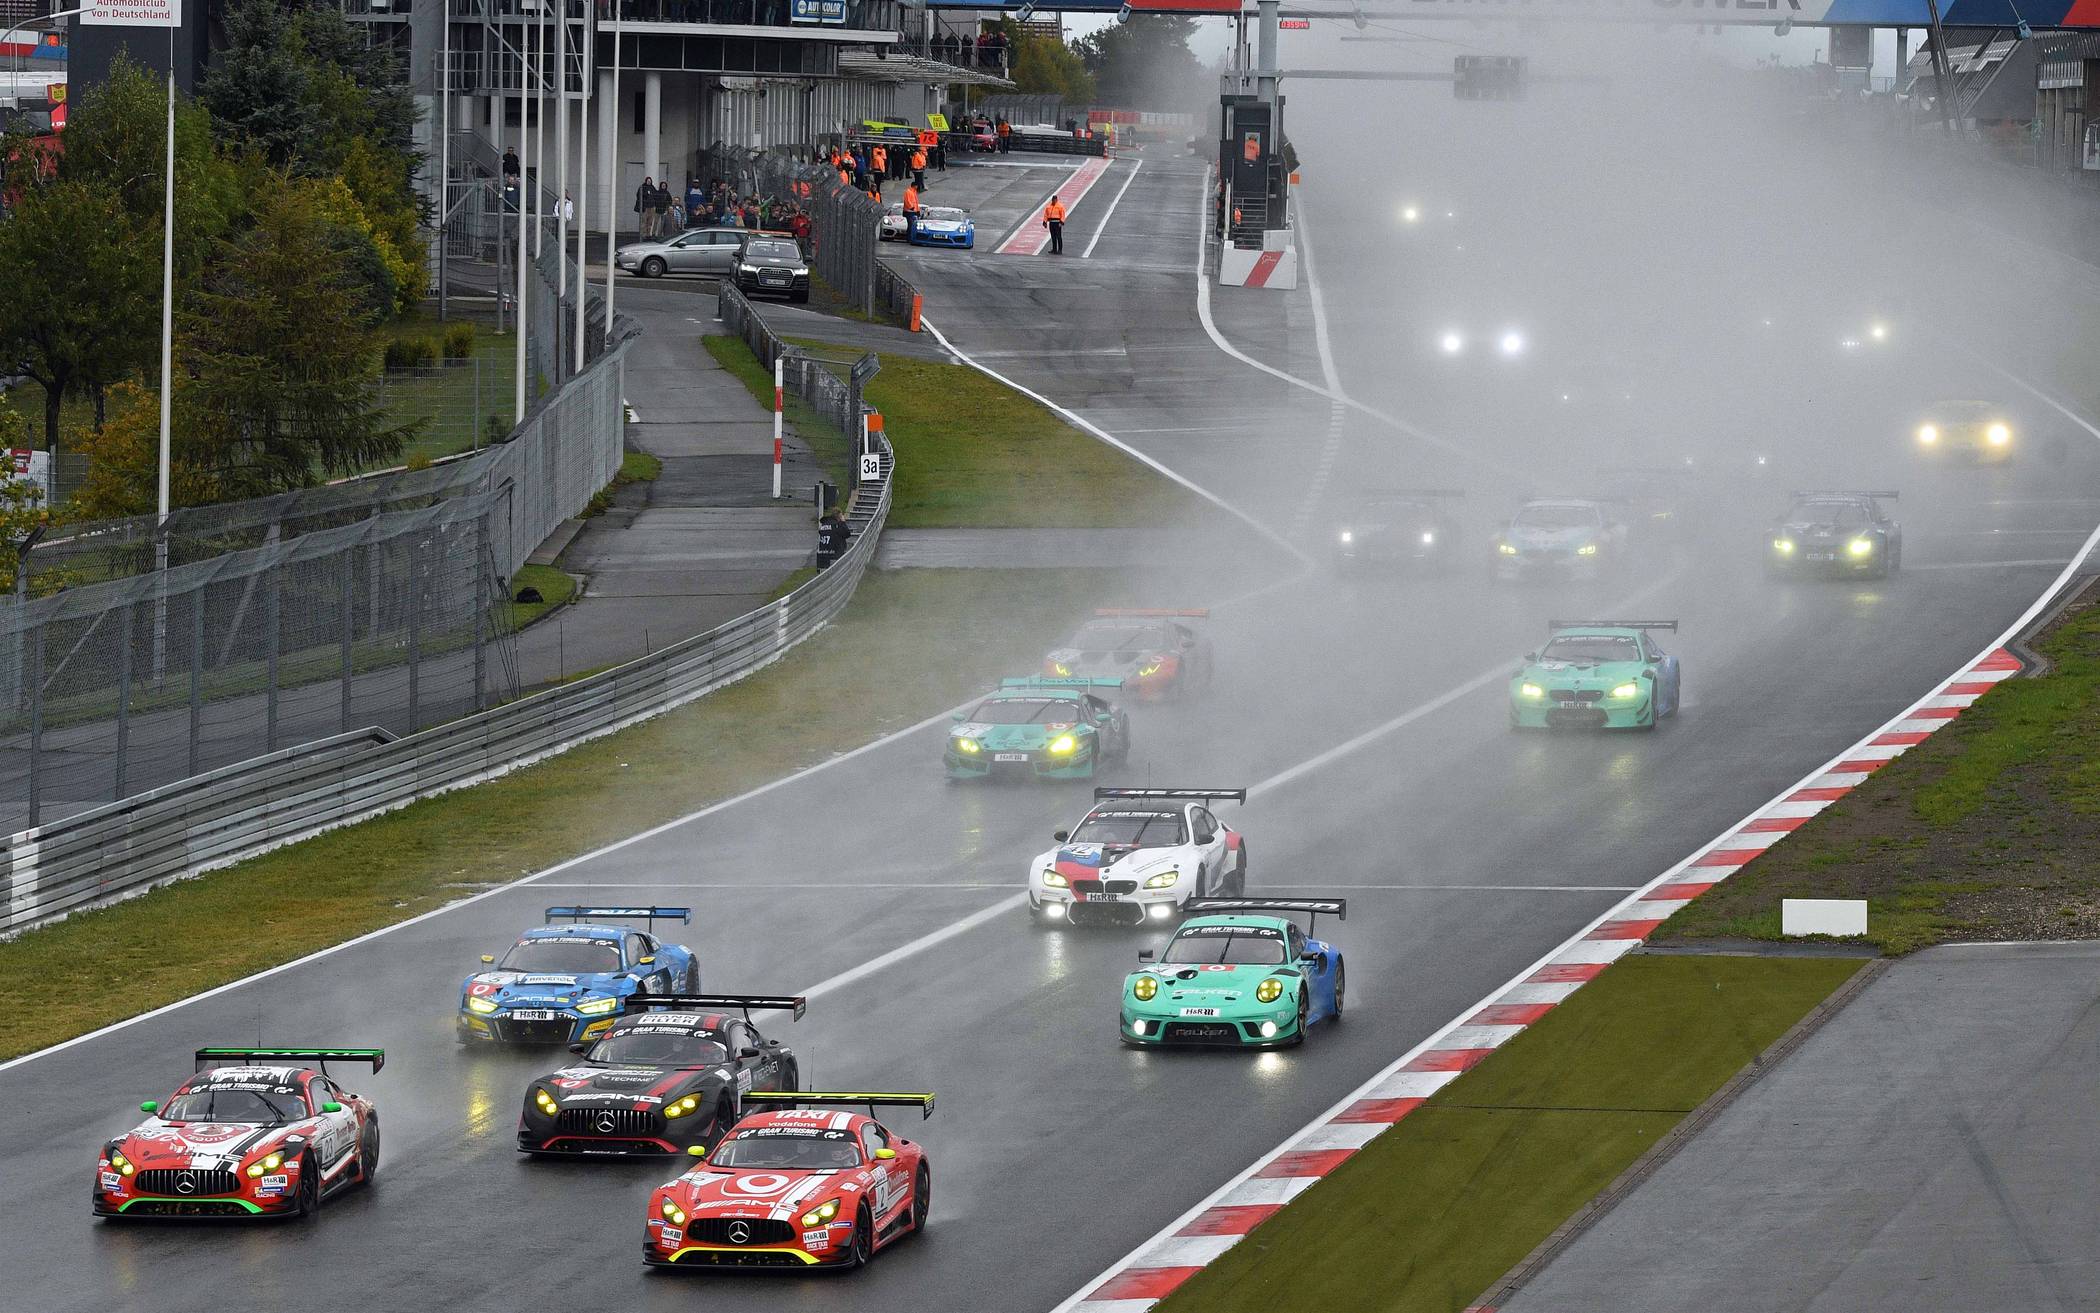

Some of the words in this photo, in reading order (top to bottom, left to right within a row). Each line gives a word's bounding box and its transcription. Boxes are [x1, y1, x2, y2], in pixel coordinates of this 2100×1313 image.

[112, 9, 170, 19] Deutschland
[863, 458, 877, 473] 3a
[632, 1026, 653, 1034] GRAN
[776, 1110, 828, 1120] TAXI
